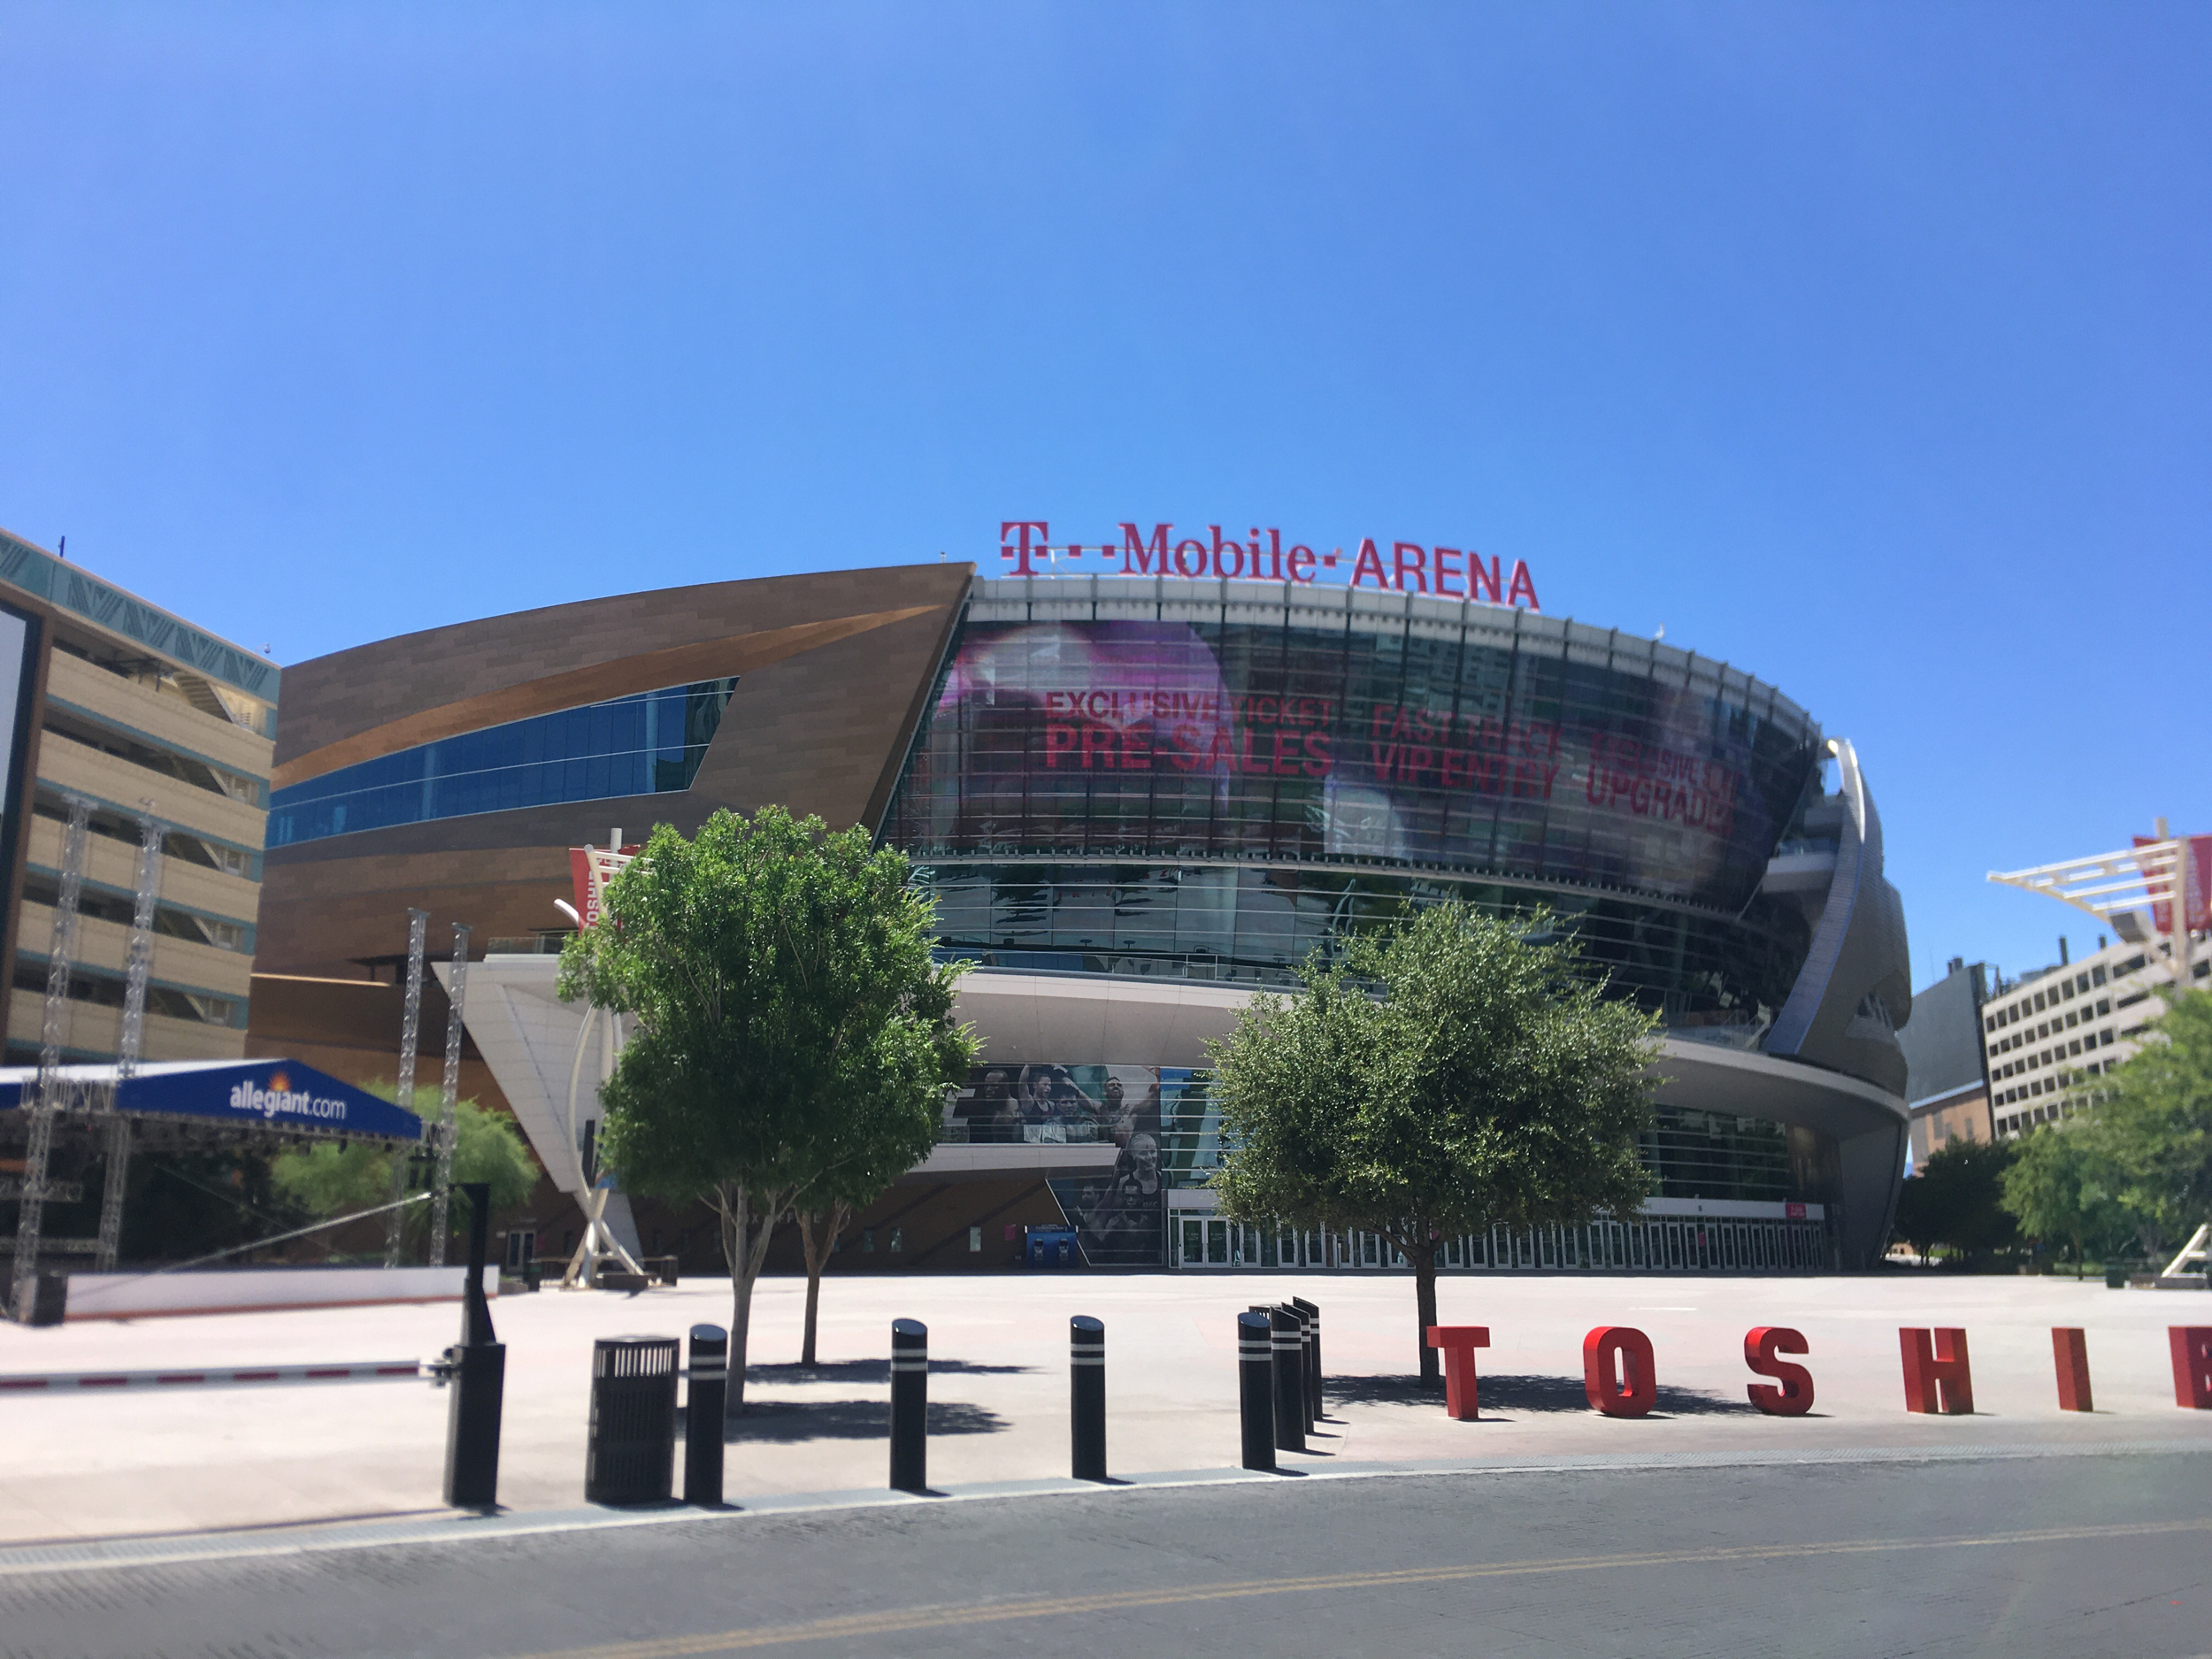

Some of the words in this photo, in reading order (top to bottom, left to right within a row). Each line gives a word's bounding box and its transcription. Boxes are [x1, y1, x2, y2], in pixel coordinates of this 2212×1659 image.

[1349, 537, 1540, 611] ARENA
[1046, 691, 1219, 722] EXCLUSIVE
[1229, 695, 1333, 727] TICKET
[1372, 704, 1454, 744] FAST
[1463, 713, 1564, 760] TRACK
[1046, 723, 1333, 777] PRE-SALES
[1371, 741, 1433, 782] VIP
[1440, 749, 1561, 800] ENTRY
[1589, 733, 1701, 786] EXCLUSIVE
[230, 1080, 347, 1120] allegiant.com
